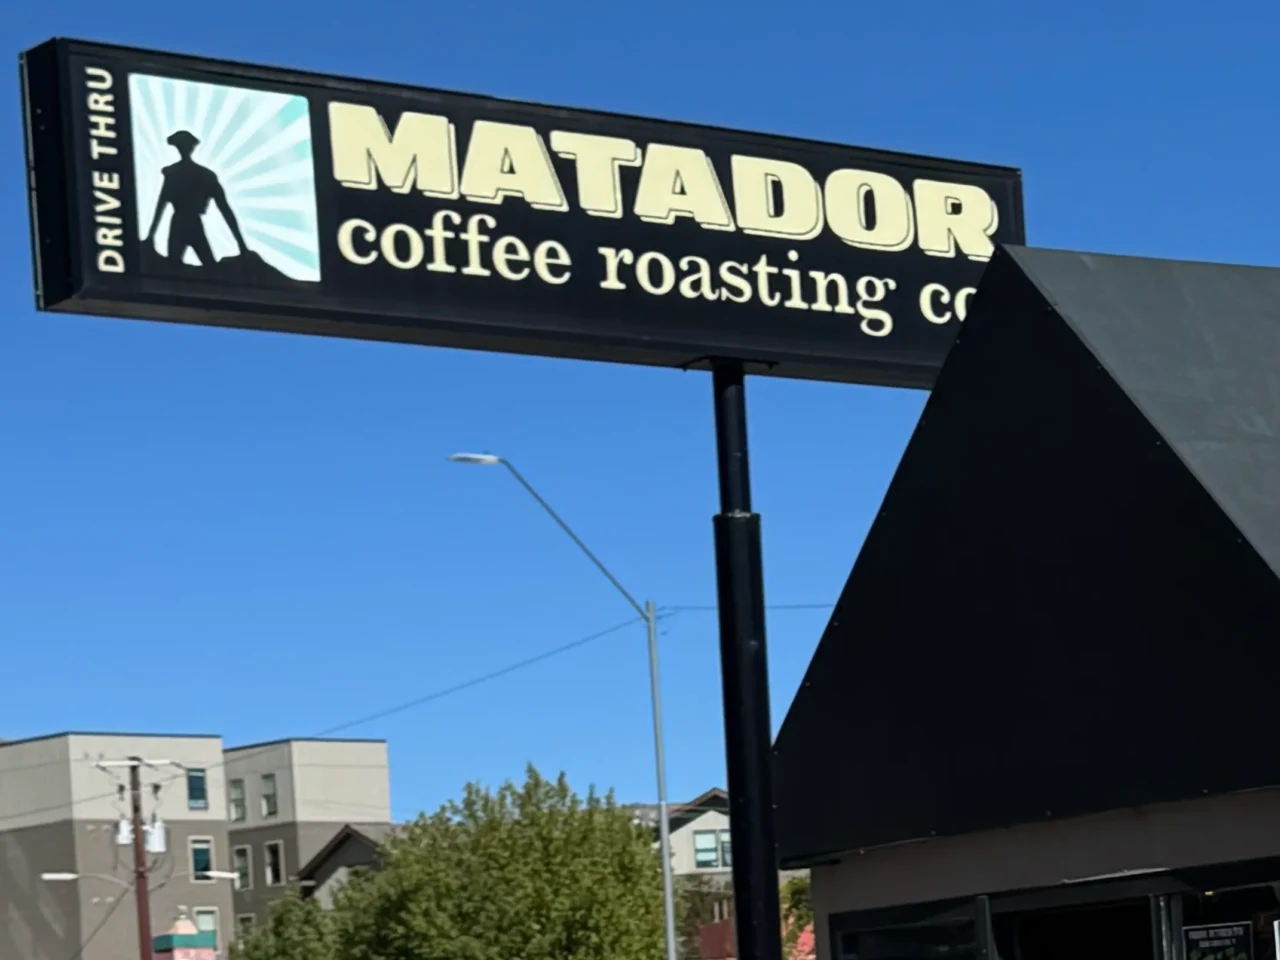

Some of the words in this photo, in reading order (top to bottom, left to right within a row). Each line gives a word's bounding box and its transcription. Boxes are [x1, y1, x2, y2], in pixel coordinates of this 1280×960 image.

[85, 66, 118, 160] THRU
[92, 171, 125, 273] DRIVE
[328, 101, 998, 262] MATADOR
[337, 210, 572, 285] coffee
[598, 247, 897, 337] roasting
